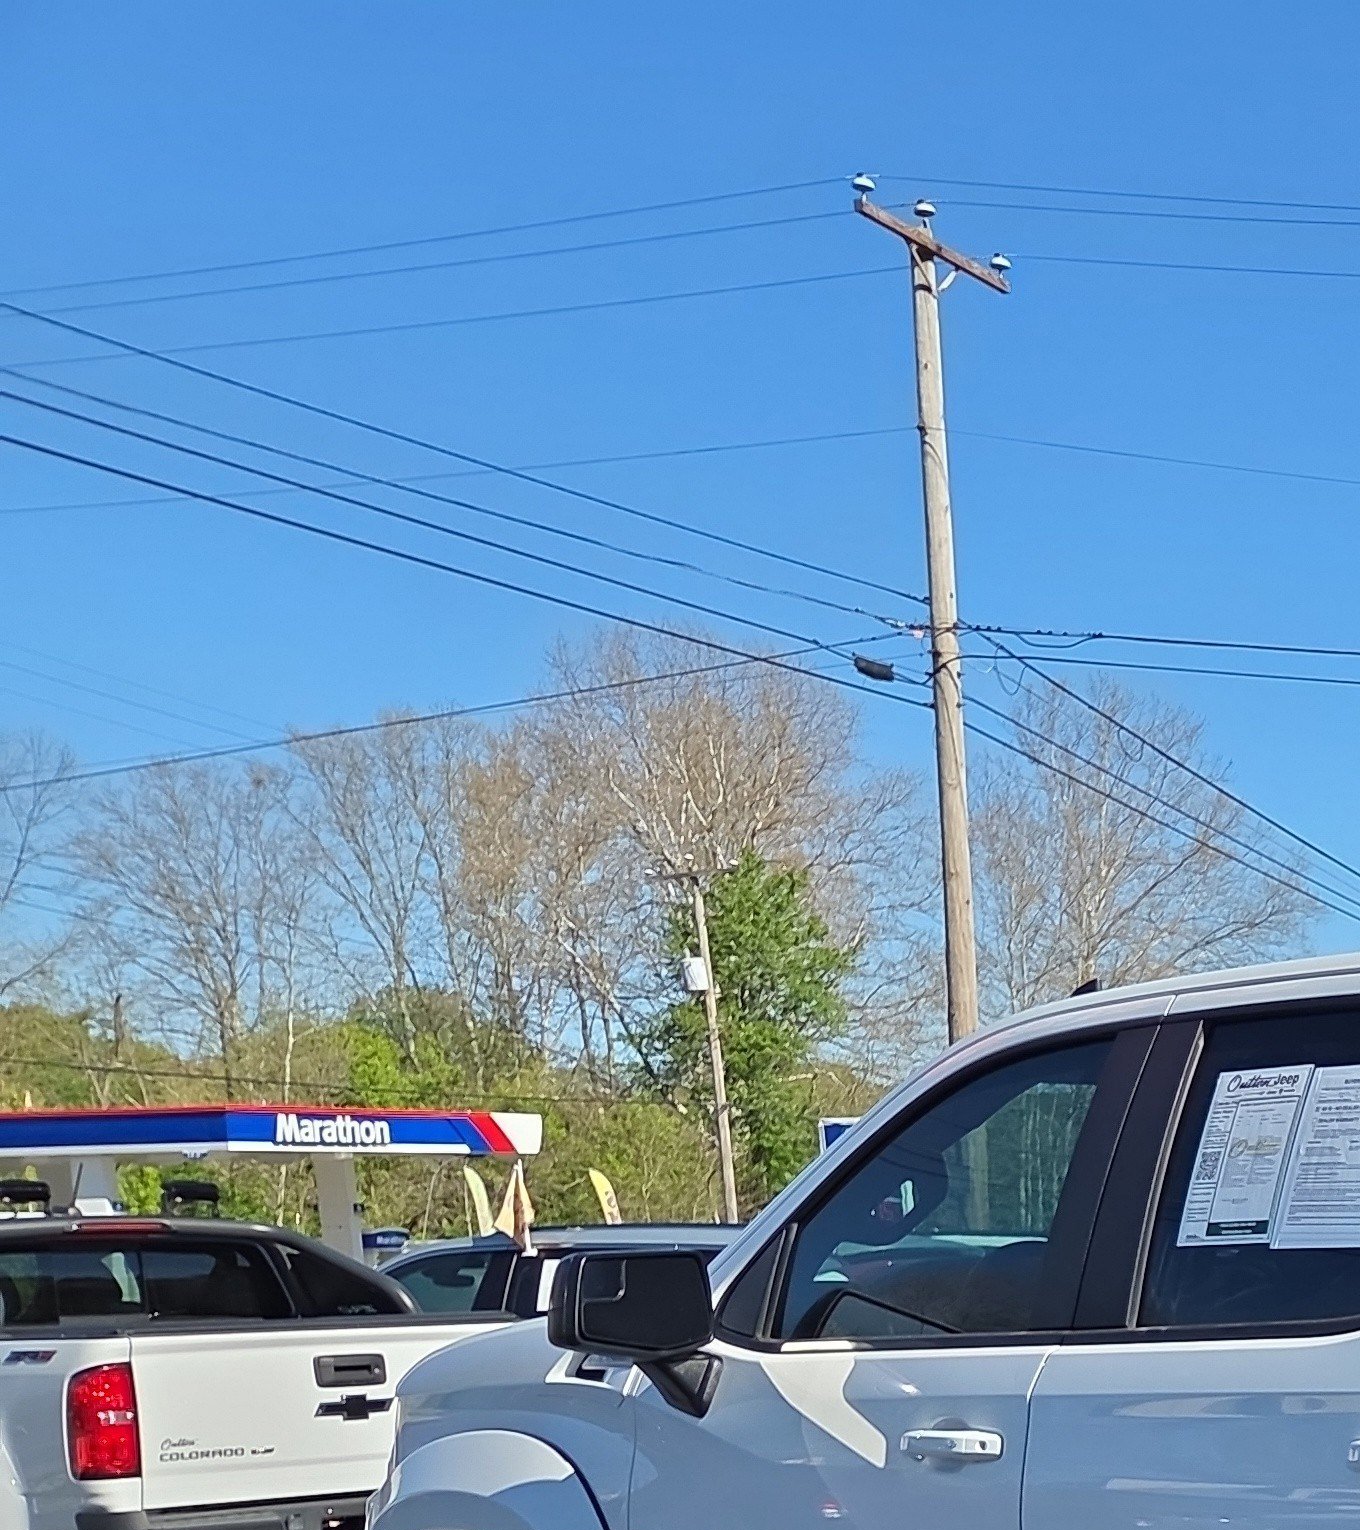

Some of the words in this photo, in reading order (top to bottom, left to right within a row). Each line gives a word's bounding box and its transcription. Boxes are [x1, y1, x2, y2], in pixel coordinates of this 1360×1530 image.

[1273, 1074, 1300, 1087] Jeep
[276, 1113, 391, 1144] Marathon
[159, 1447, 245, 1463] COLORADO
